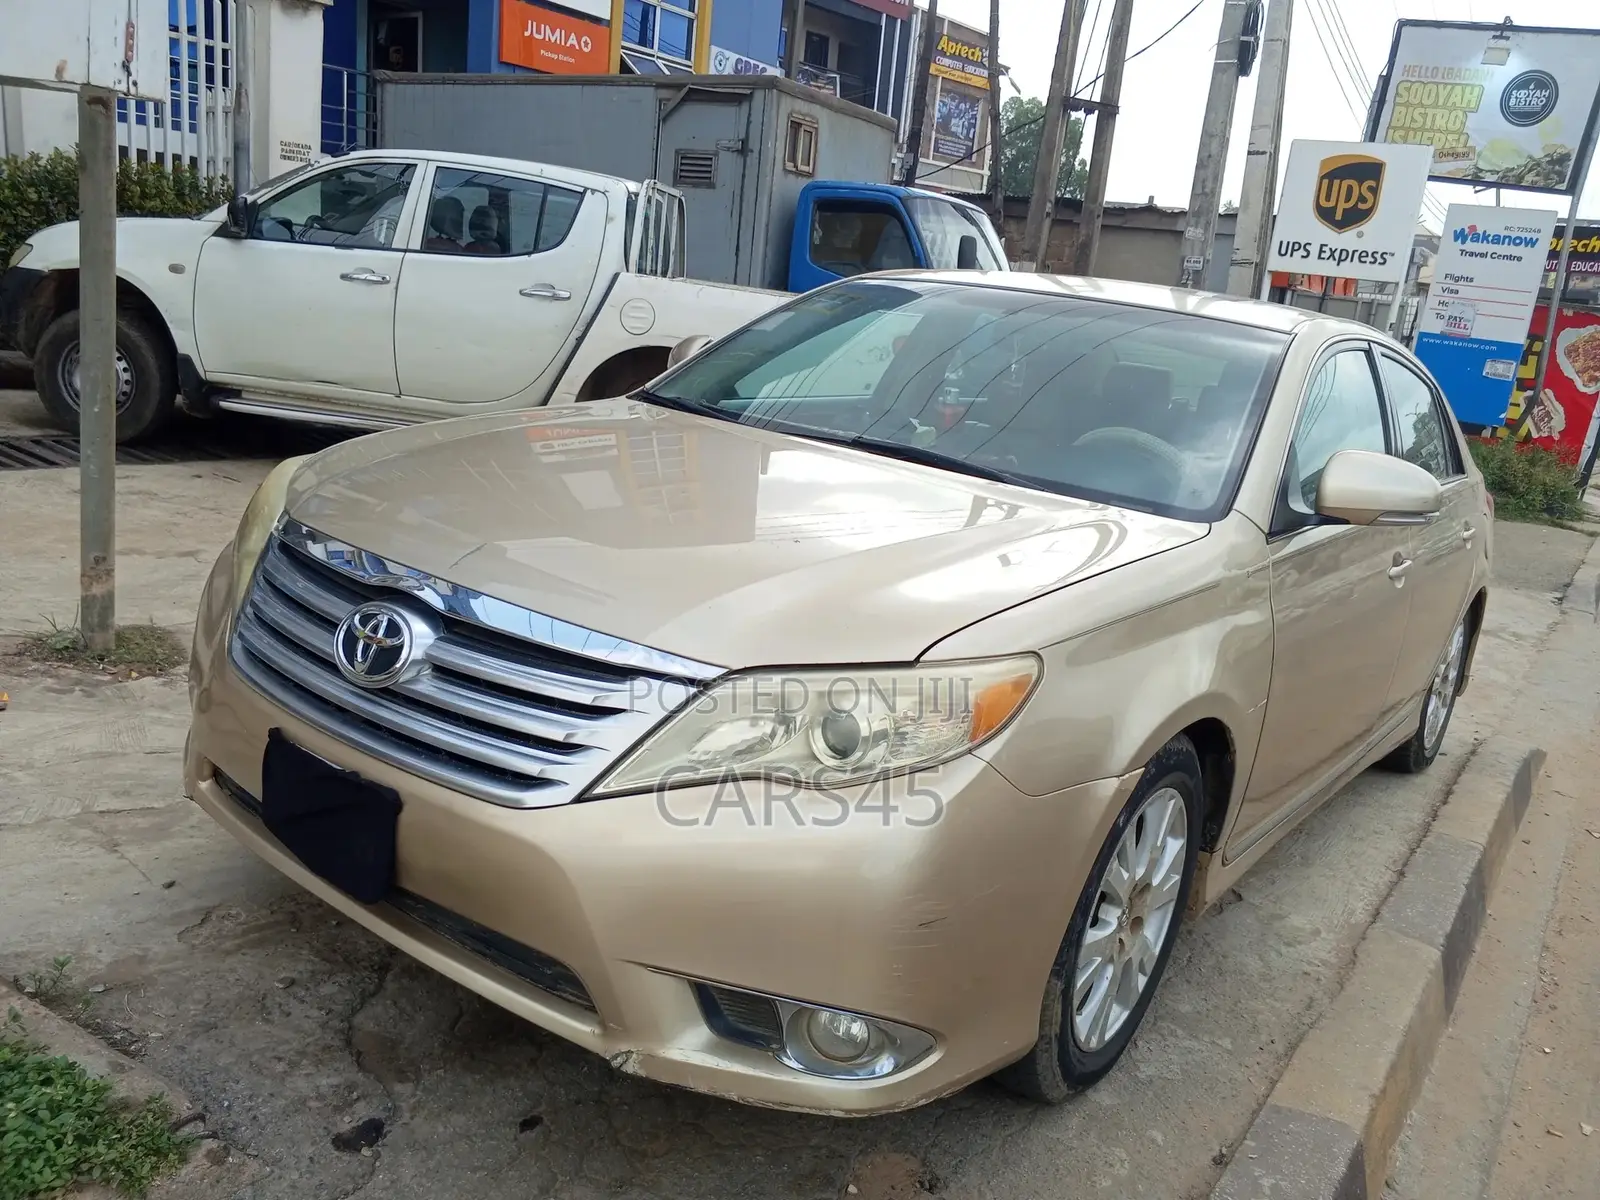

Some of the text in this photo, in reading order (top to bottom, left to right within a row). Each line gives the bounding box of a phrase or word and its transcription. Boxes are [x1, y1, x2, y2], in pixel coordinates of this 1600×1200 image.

[524, 20, 579, 50] JUMIA
[937, 35, 983, 62] Aptech
[540, 49, 576, 64] Pickup Station
[935, 56, 963, 71] COMPUTER
[1402, 65, 1439, 79] HELLO
[1395, 81, 1482, 109] SOOYAH
[1510, 89, 1550, 99] SOOYAH
[1508, 97, 1546, 107] BISTRO
[1390, 105, 1466, 131] BISTRO
[1453, 228, 1539, 248] Wakanow
[1548, 236, 1600, 254] ptech
[1278, 240, 1312, 259] UPS
[1459, 249, 1523, 262] Travel Centre
[1444, 273, 1474, 284] Flights
[1441, 286, 1459, 295] Visa
[1445, 321, 1469, 331] BILL
[1422, 338, 1497, 351] www.wakanow.com
